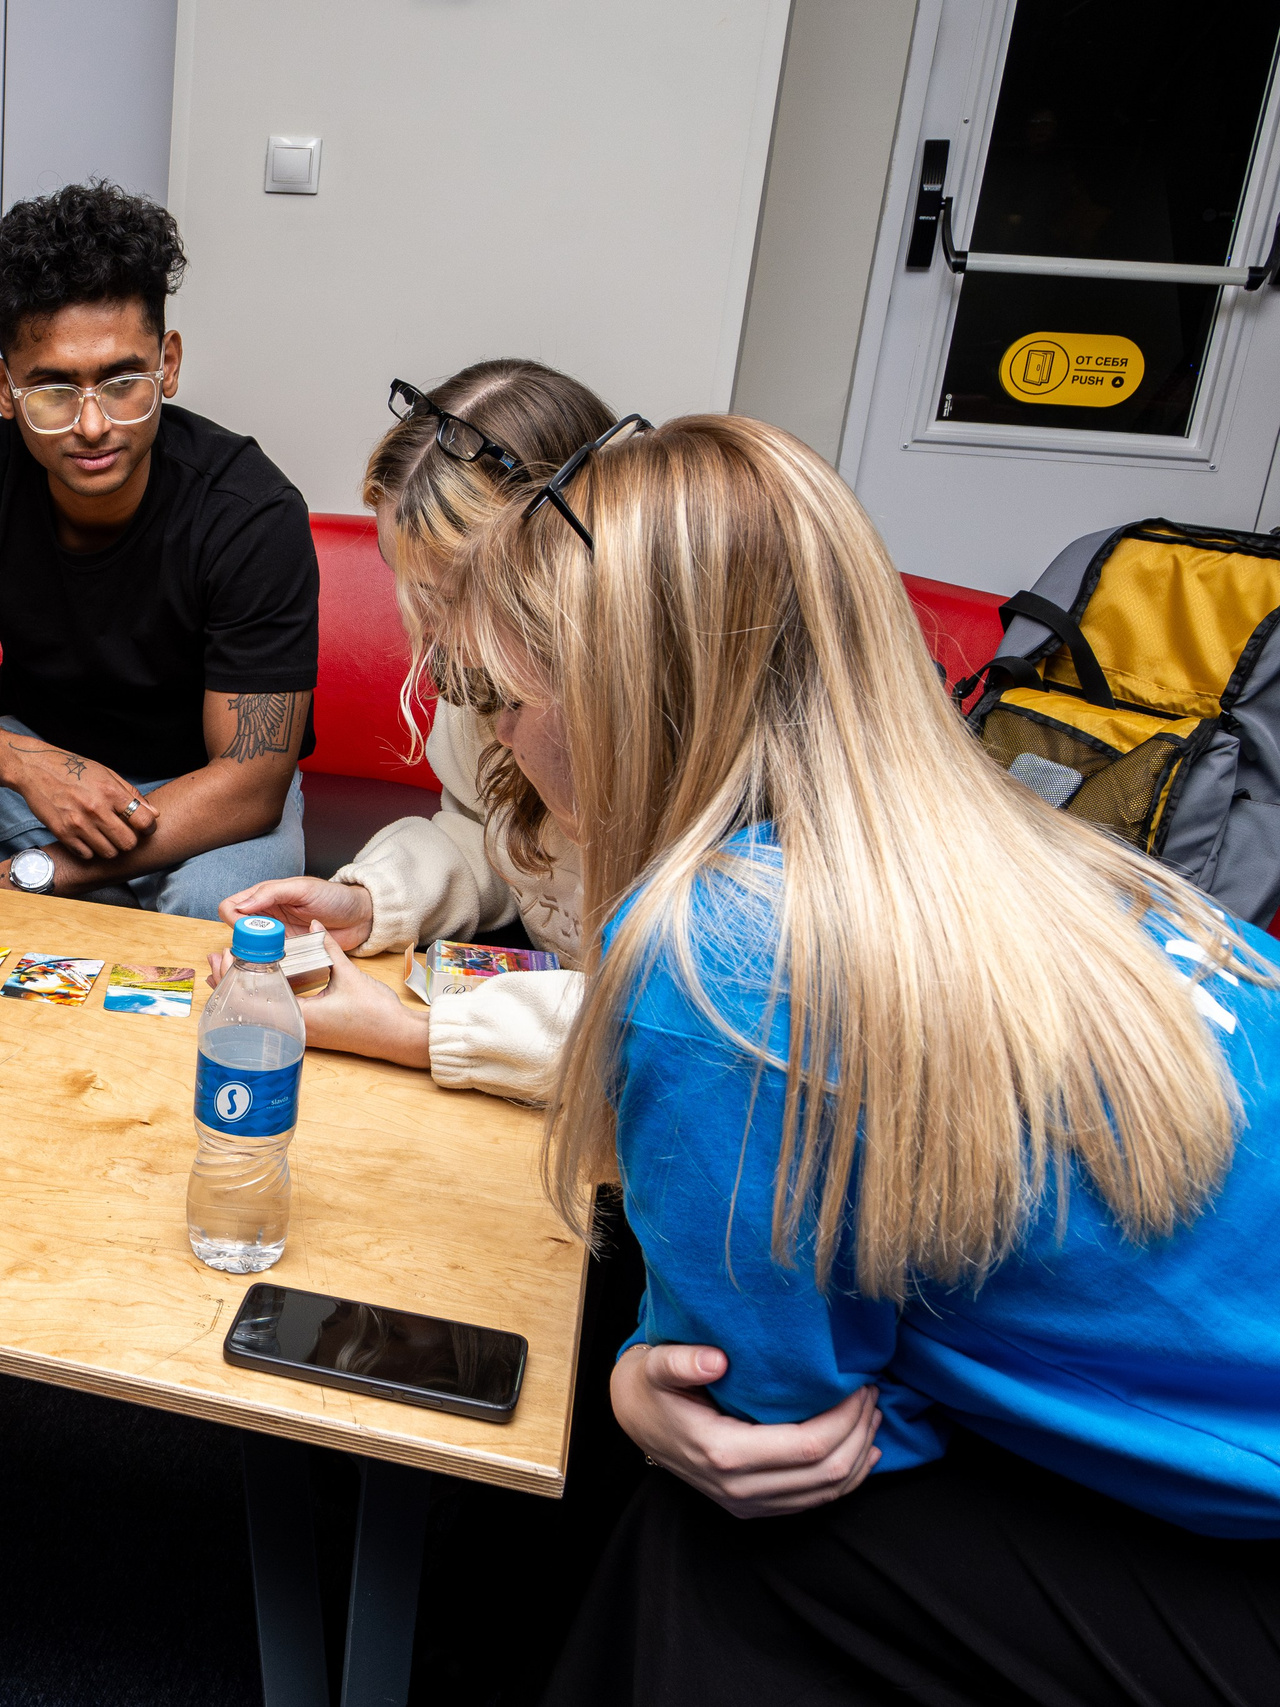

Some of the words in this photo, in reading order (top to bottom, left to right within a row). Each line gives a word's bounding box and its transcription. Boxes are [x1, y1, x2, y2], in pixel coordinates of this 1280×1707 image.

[1075, 355, 1093, 366] ОТ
[1095, 356, 1128, 368] СЕБЯ
[1071, 375, 1104, 386] PUSH
